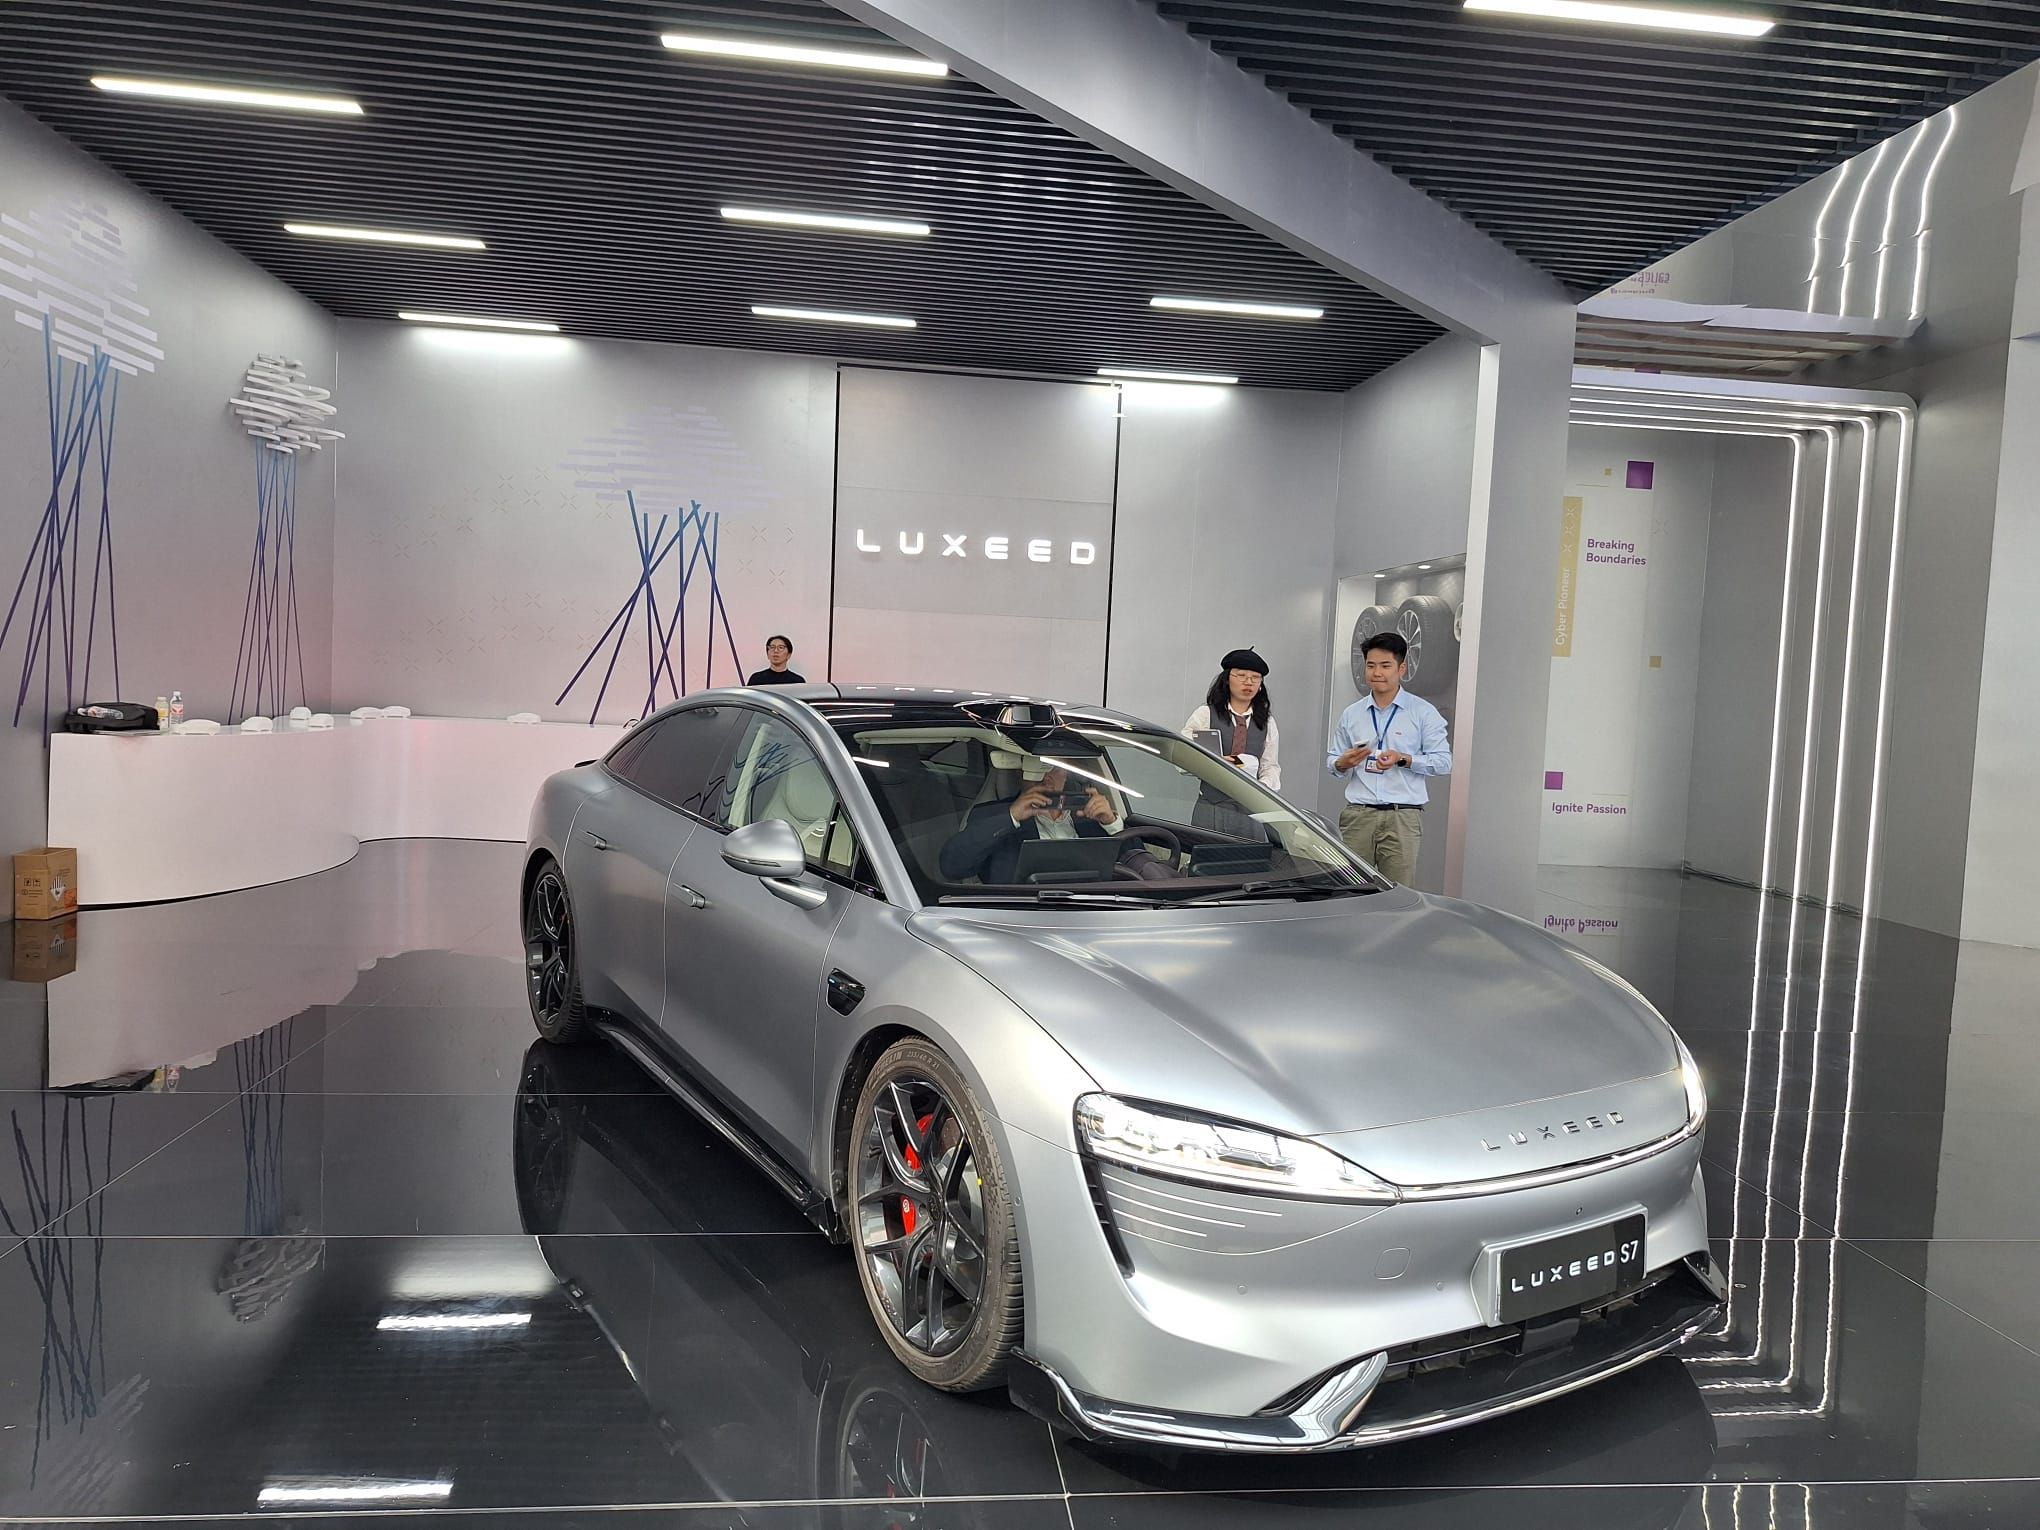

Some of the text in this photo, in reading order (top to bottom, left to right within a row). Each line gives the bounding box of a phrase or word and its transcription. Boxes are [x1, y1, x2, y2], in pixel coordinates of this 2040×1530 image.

[856, 528, 1096, 566] LUXEED
[1585, 552, 1647, 566] Boundaries
[1586, 538, 1635, 553] Breaking
[1555, 568, 1570, 646] Cyber Pioneer
[1552, 801, 1627, 815] Ignite Passion
[1480, 1111, 1624, 1152] LUXEED
[1511, 1239, 1639, 1293] LUXEED S7
